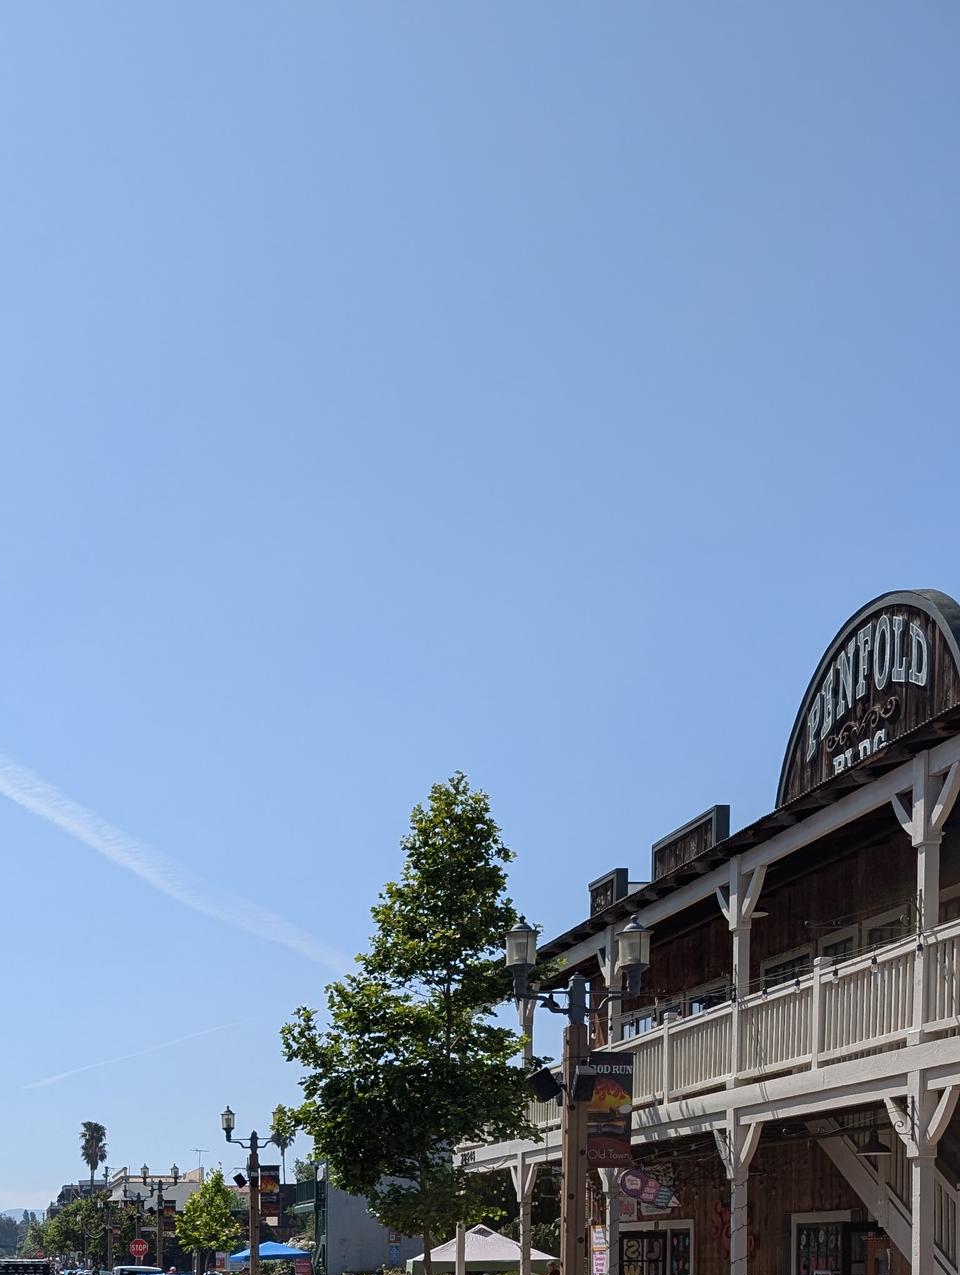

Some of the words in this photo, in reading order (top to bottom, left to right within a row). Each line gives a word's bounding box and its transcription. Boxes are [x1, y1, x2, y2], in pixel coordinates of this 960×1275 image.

[806, 615, 928, 762] PENFOLD
[612, 1064, 633, 1075] RUN
[587, 1148, 606, 1160] Old
[608, 1149, 630, 1160] Town
